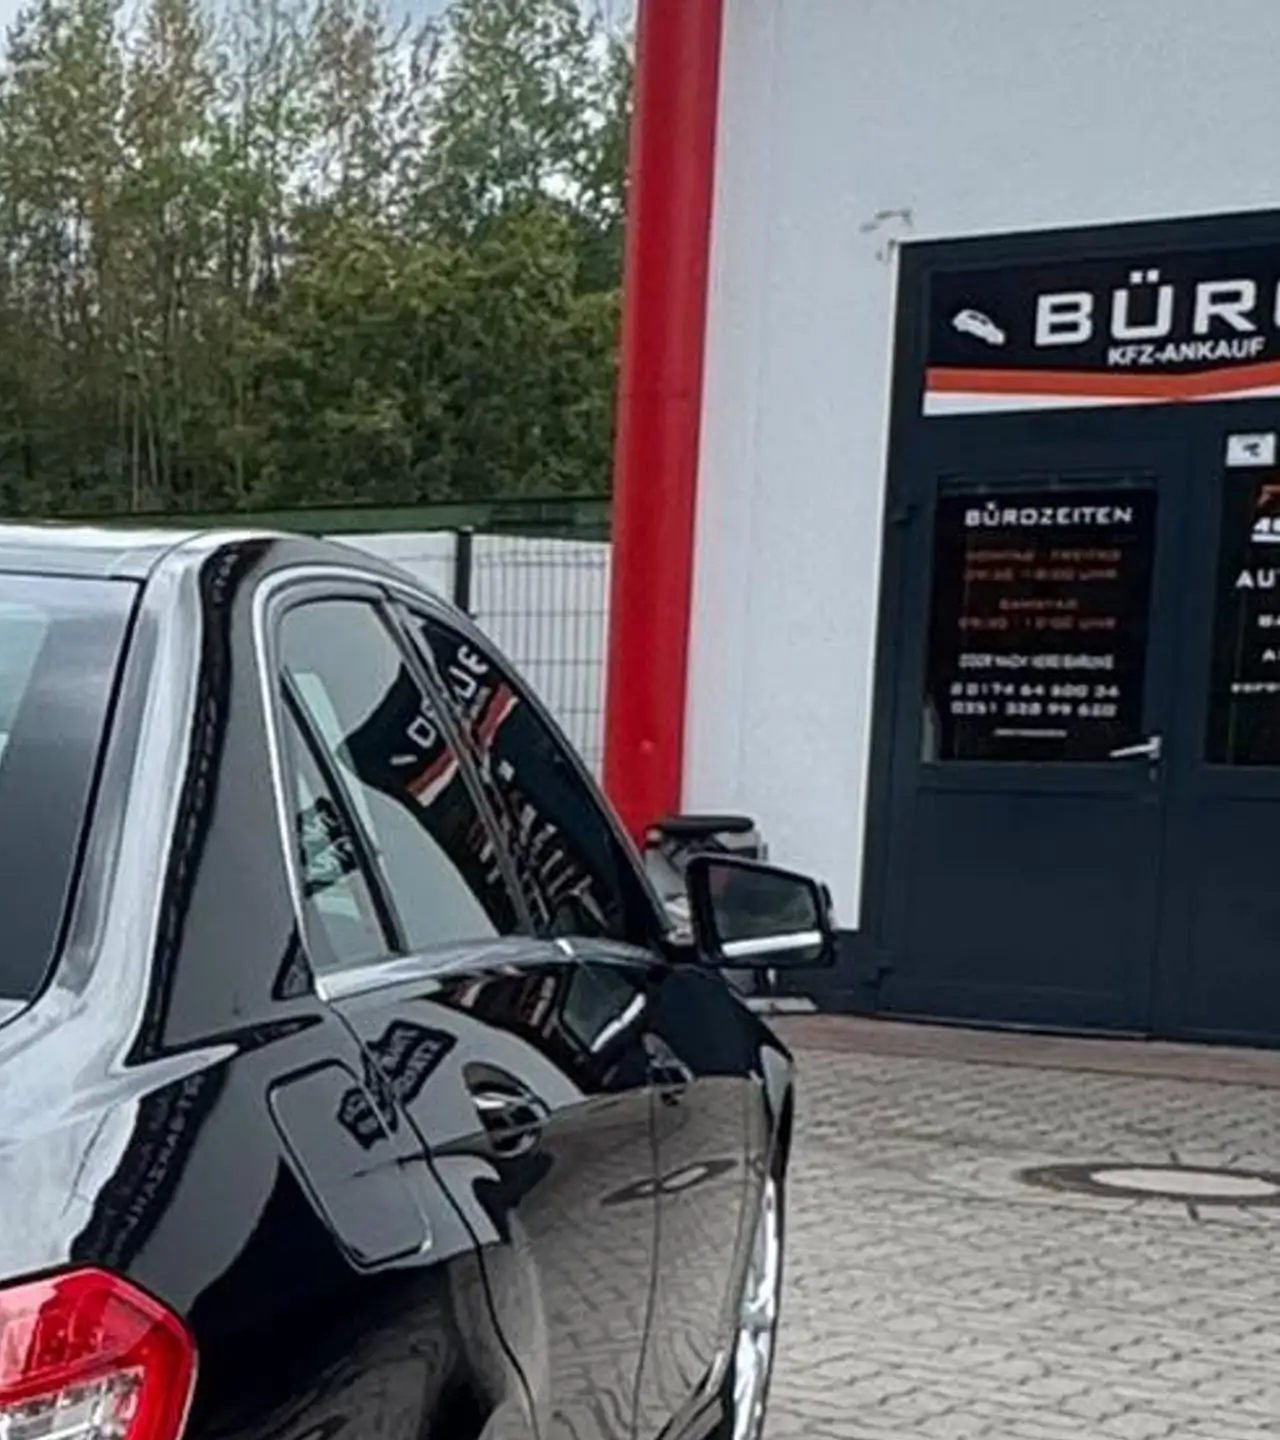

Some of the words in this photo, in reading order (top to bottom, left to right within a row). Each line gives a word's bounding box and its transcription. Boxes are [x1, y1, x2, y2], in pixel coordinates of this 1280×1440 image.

[1034, 268, 1280, 347] BÜR
[1106, 336, 1267, 366] KFZ-ANKAUF
[964, 501, 1133, 527] BÜROZEITEN
[1235, 567, 1280, 589] AU
